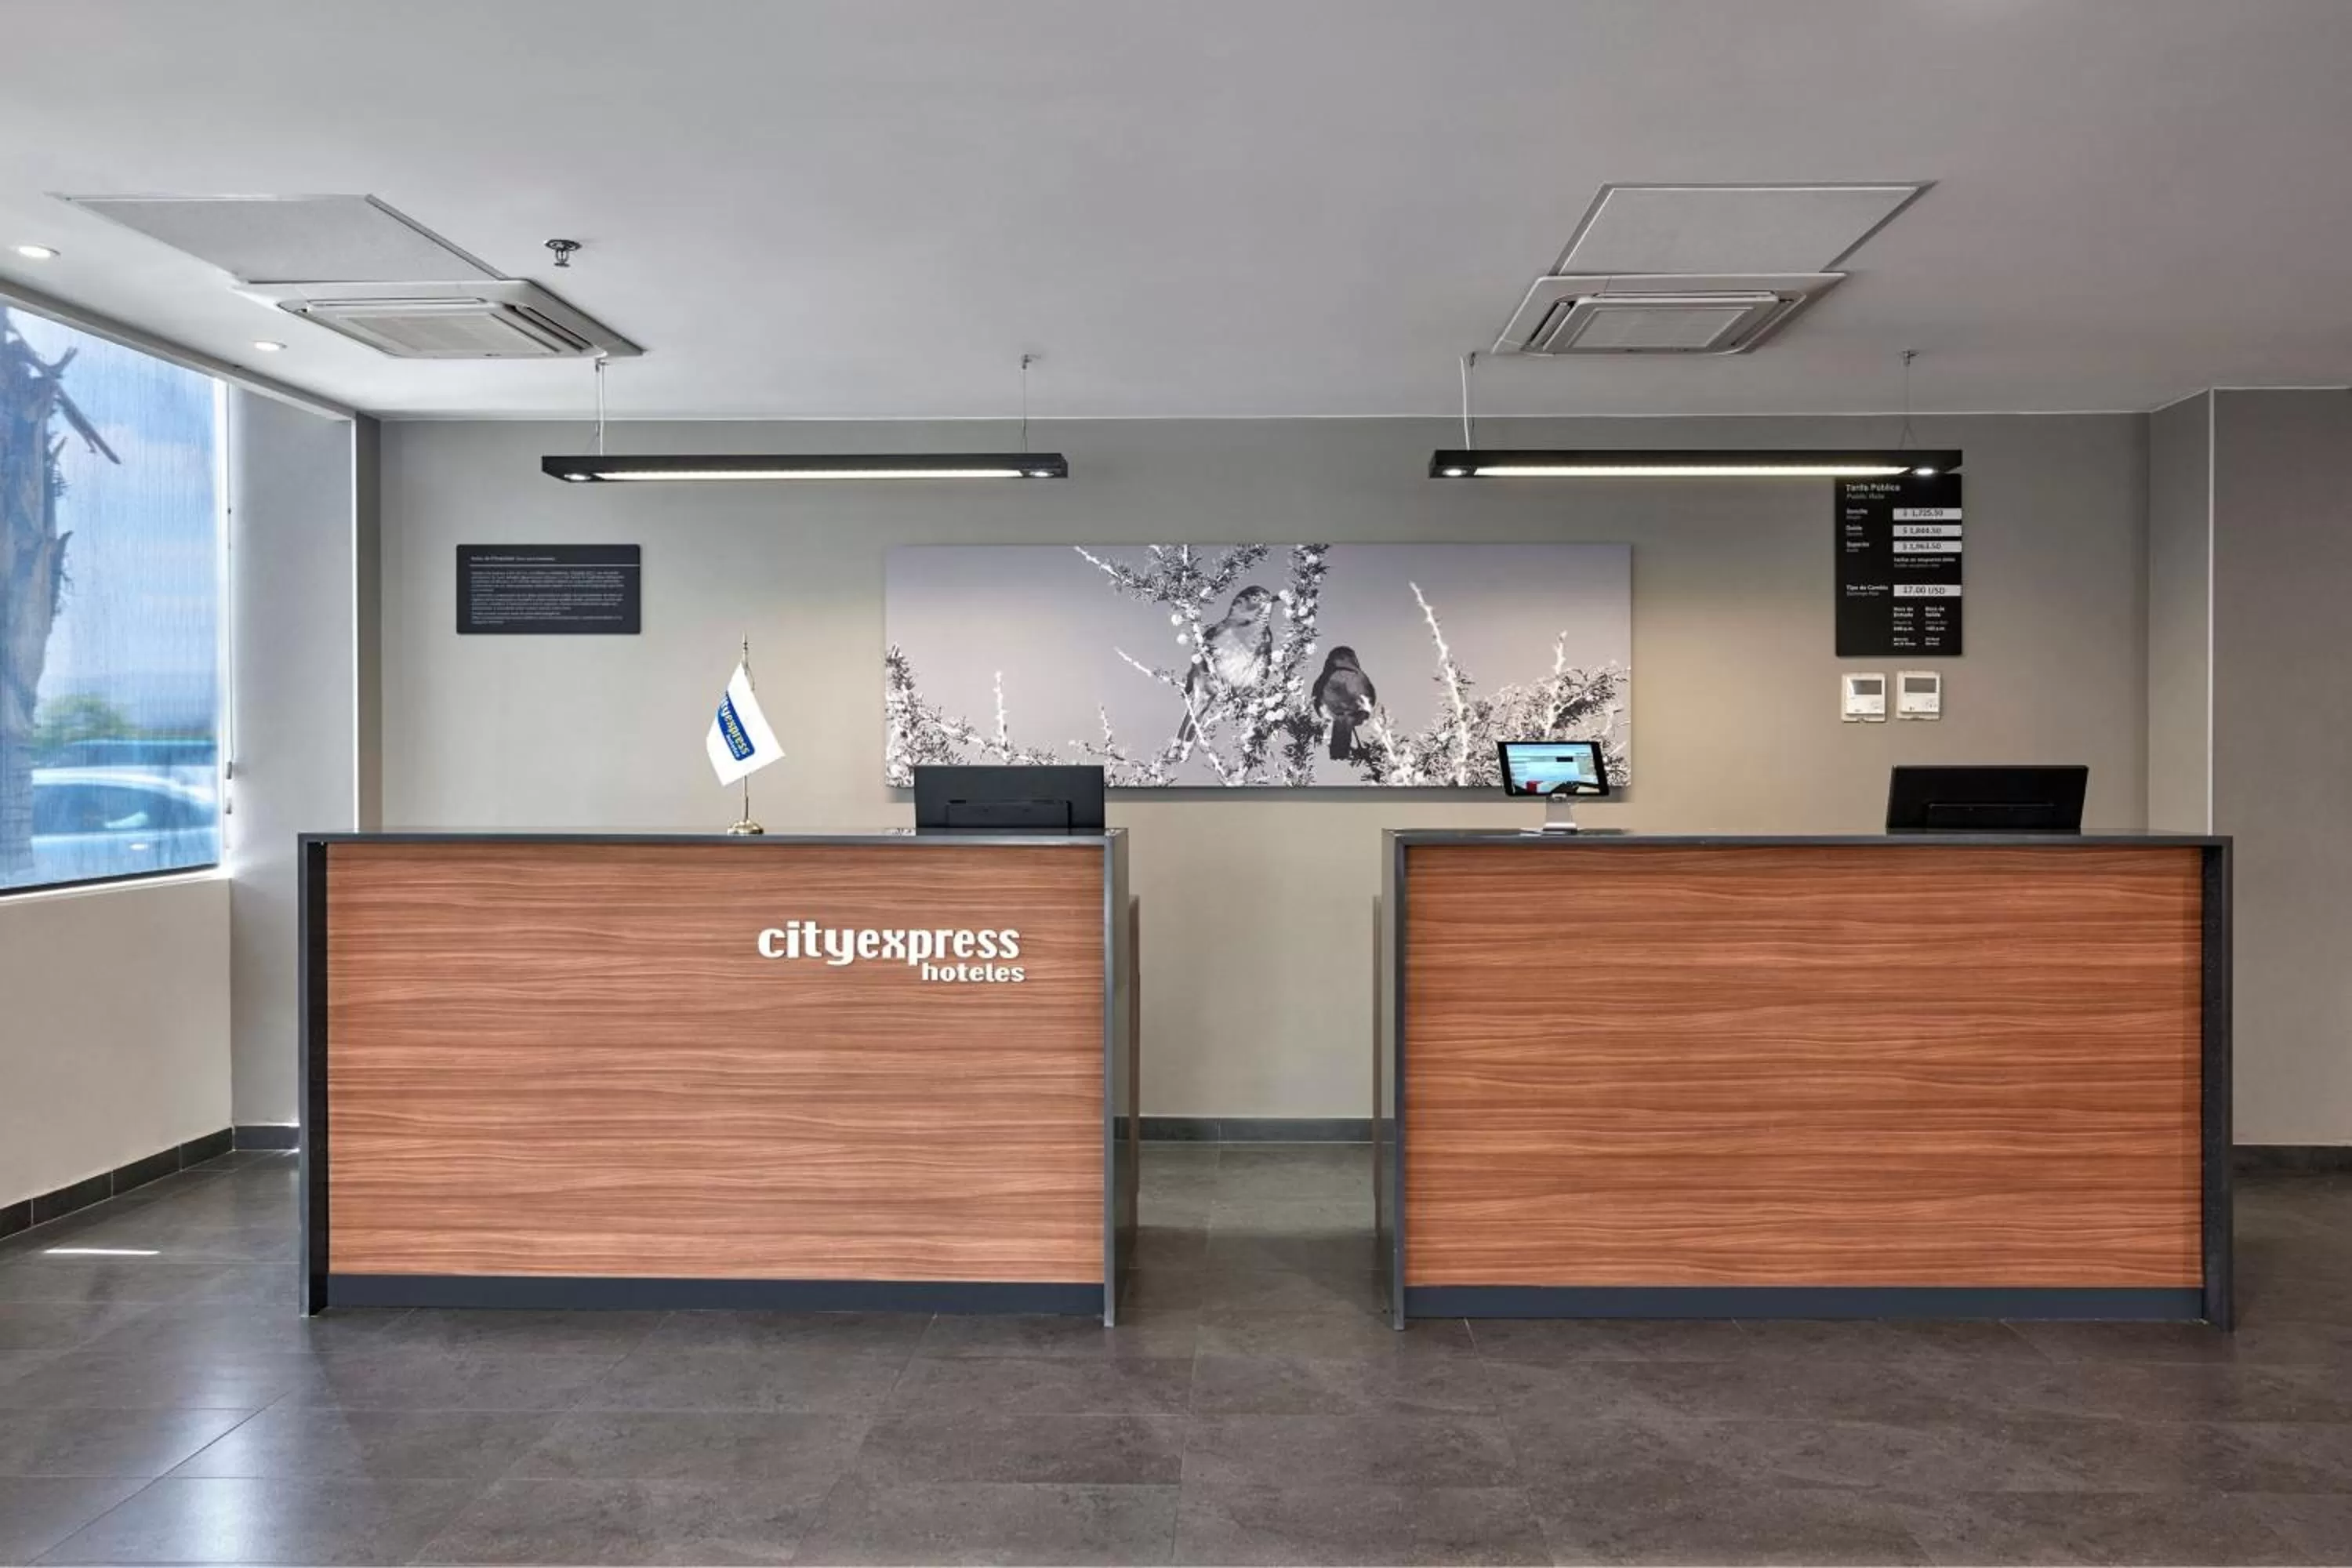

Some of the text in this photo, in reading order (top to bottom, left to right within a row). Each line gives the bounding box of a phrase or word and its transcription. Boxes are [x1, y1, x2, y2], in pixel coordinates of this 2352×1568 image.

[1903, 586, 1946, 595] 17.00 USD
[757, 920, 1021, 967] cityexpress
[921, 962, 1026, 983] hoteles
